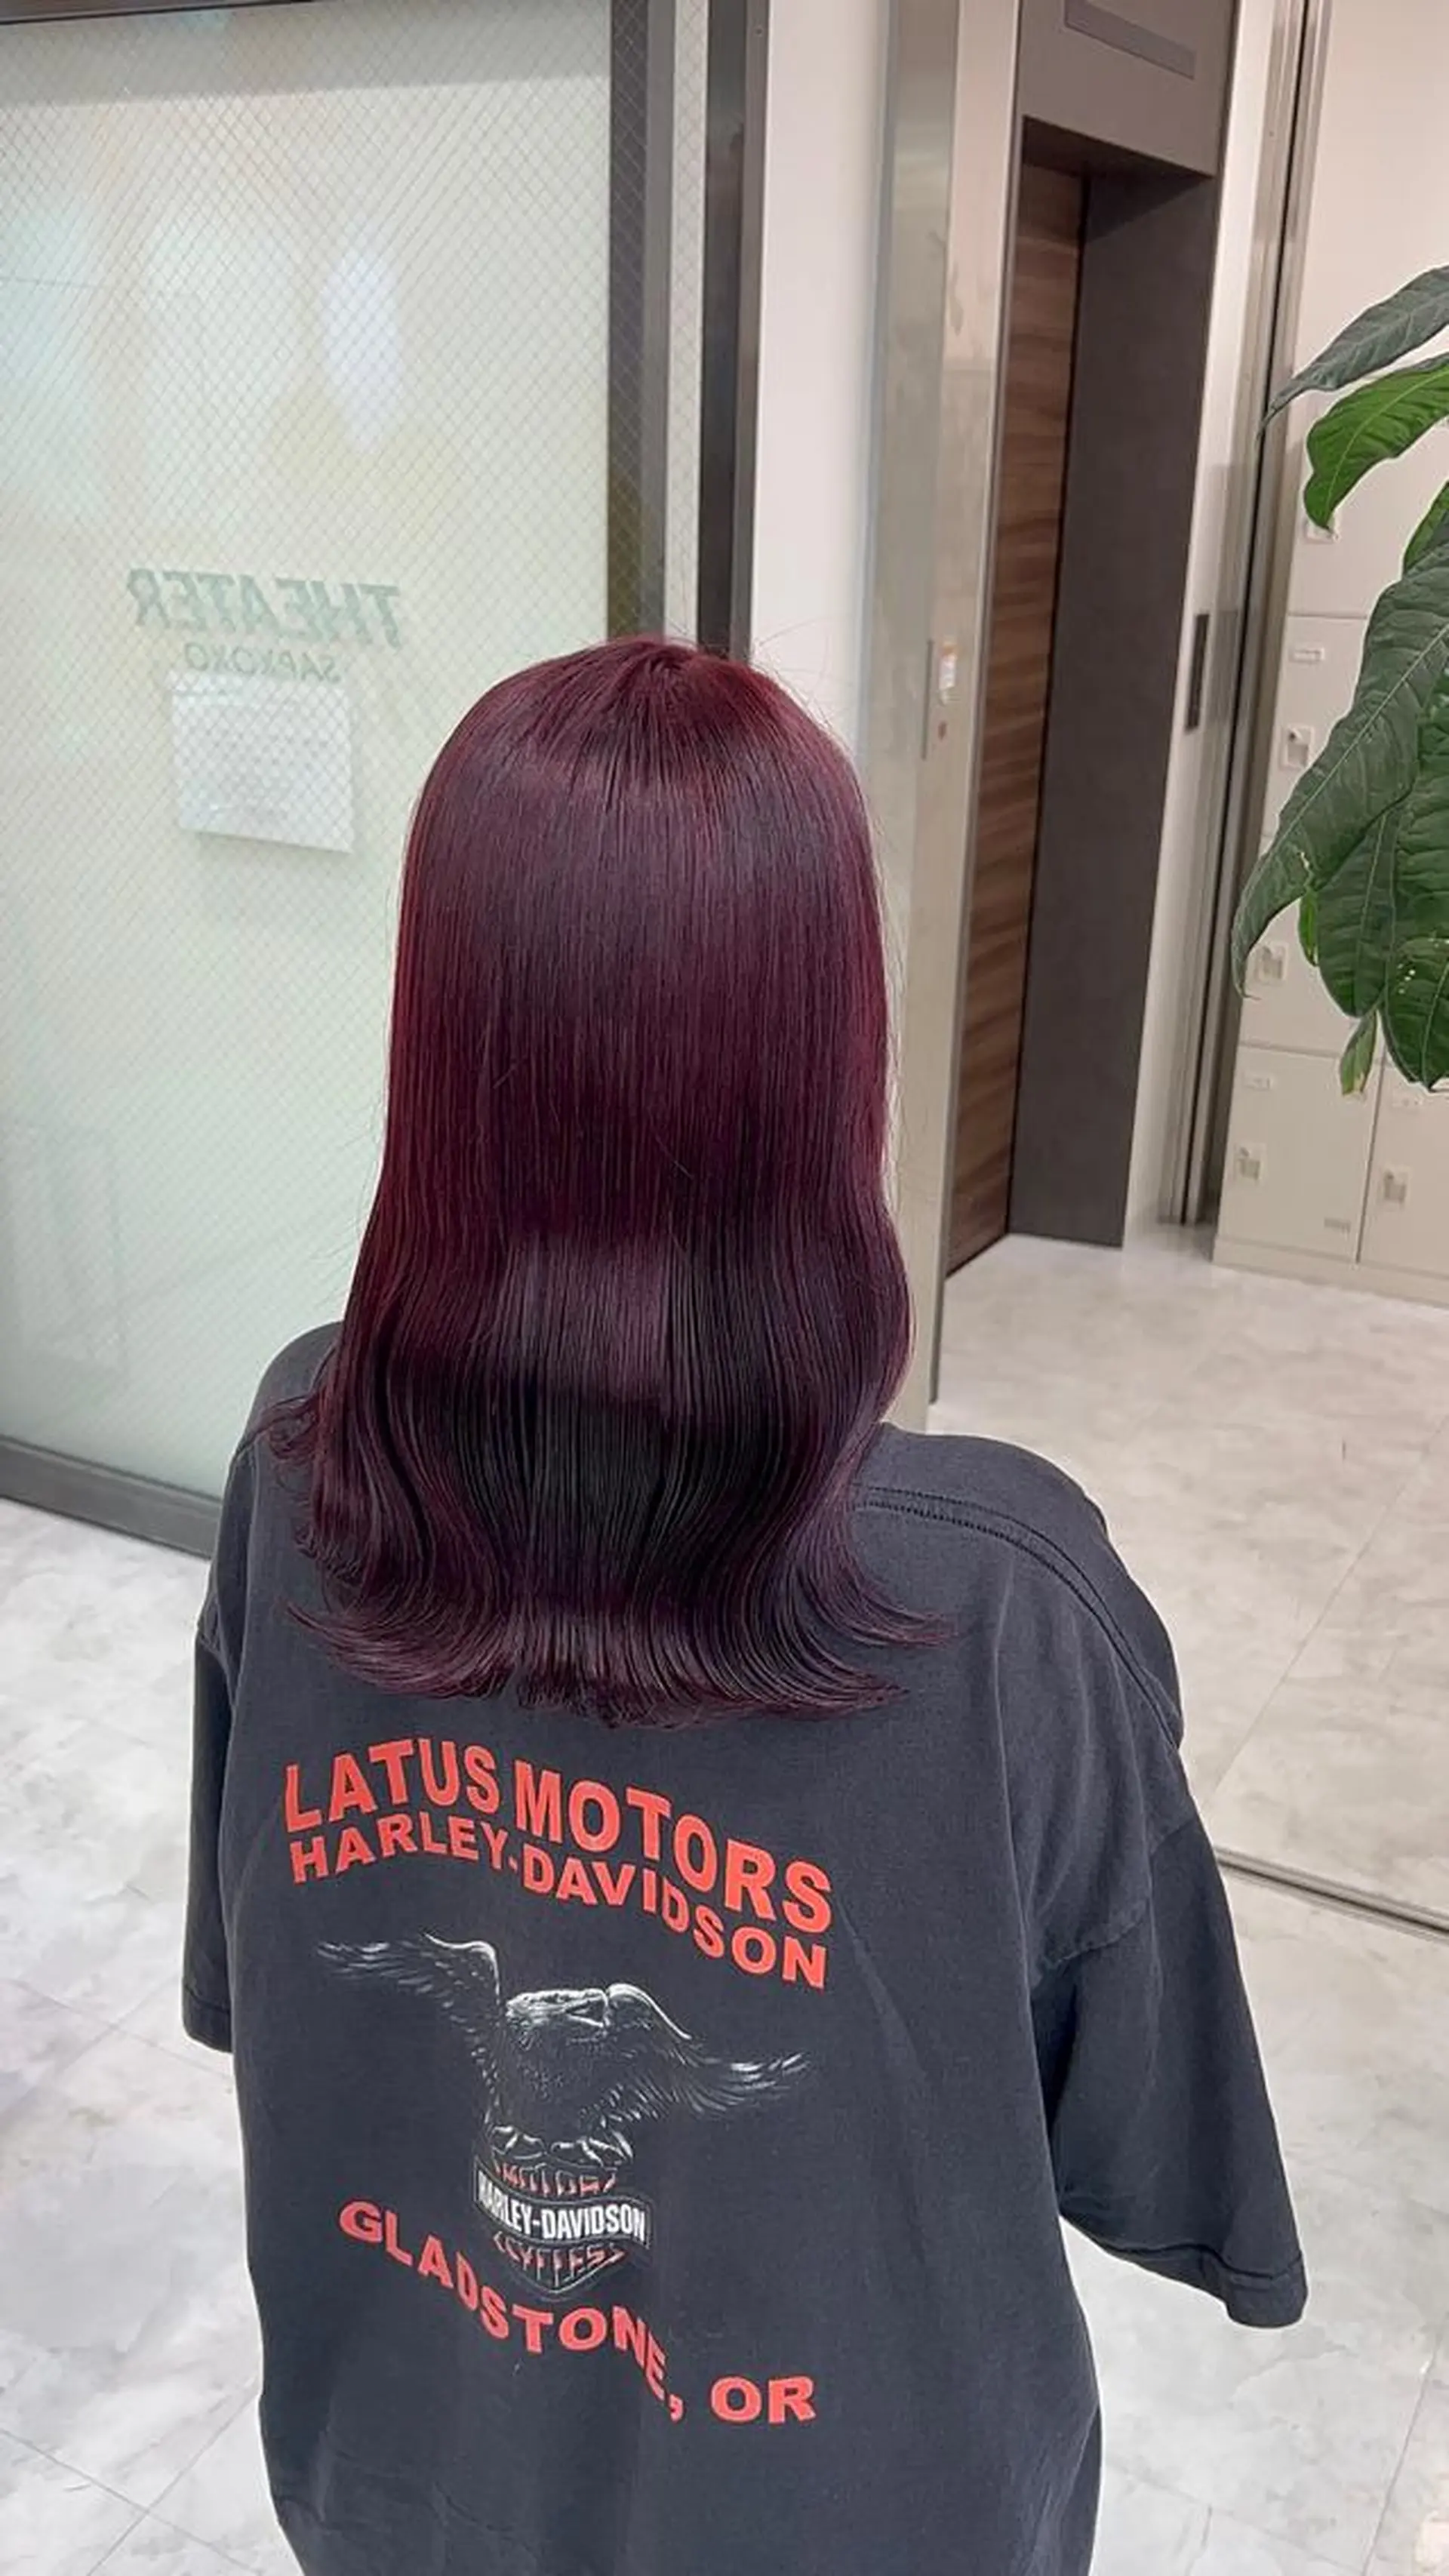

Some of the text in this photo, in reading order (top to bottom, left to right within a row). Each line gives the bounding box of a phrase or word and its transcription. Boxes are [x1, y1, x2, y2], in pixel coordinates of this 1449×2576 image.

[285, 1738, 832, 1934] LATUS MOTORS
[289, 1811, 828, 1990] HARLEY-DAVIDSON
[478, 2169, 646, 2242] HARLEY-DAVIDSON
[338, 2200, 816, 2424] GLADSTONE, OR
